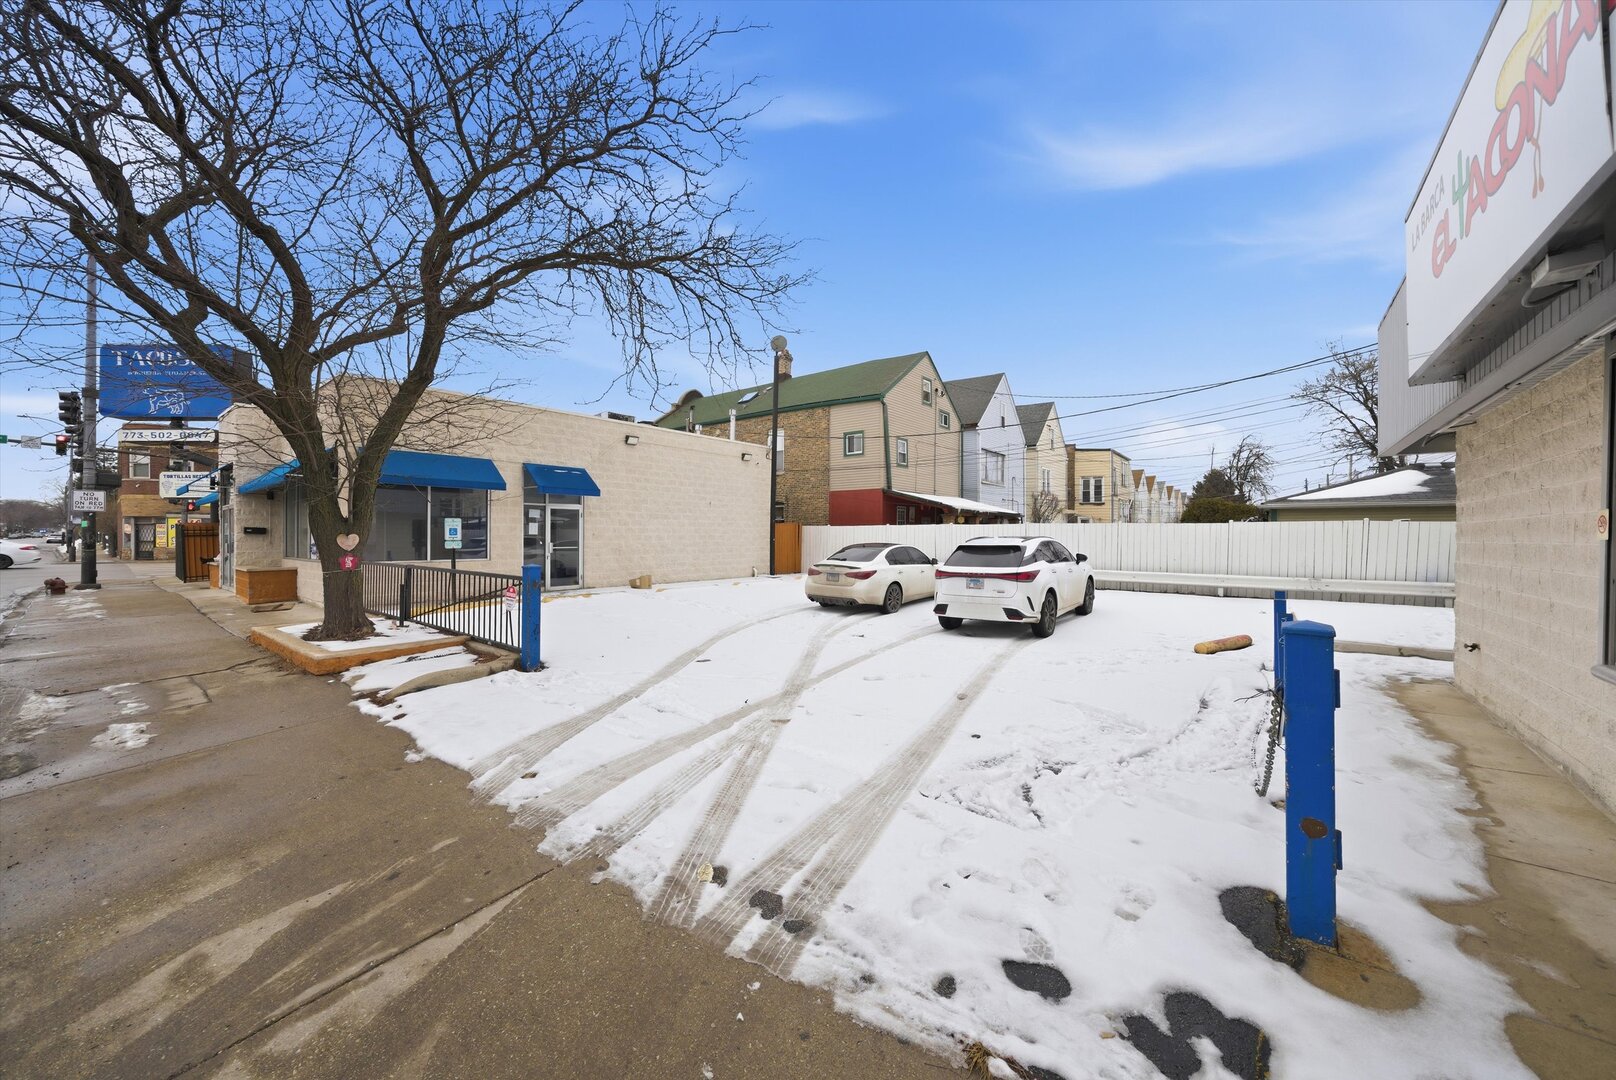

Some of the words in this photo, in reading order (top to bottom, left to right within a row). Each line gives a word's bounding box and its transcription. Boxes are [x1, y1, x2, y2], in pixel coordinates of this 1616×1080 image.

[1411, 229, 1421, 251] LA
[1421, 175, 1445, 237] BARCA
[1431, 207, 1457, 279] EL
